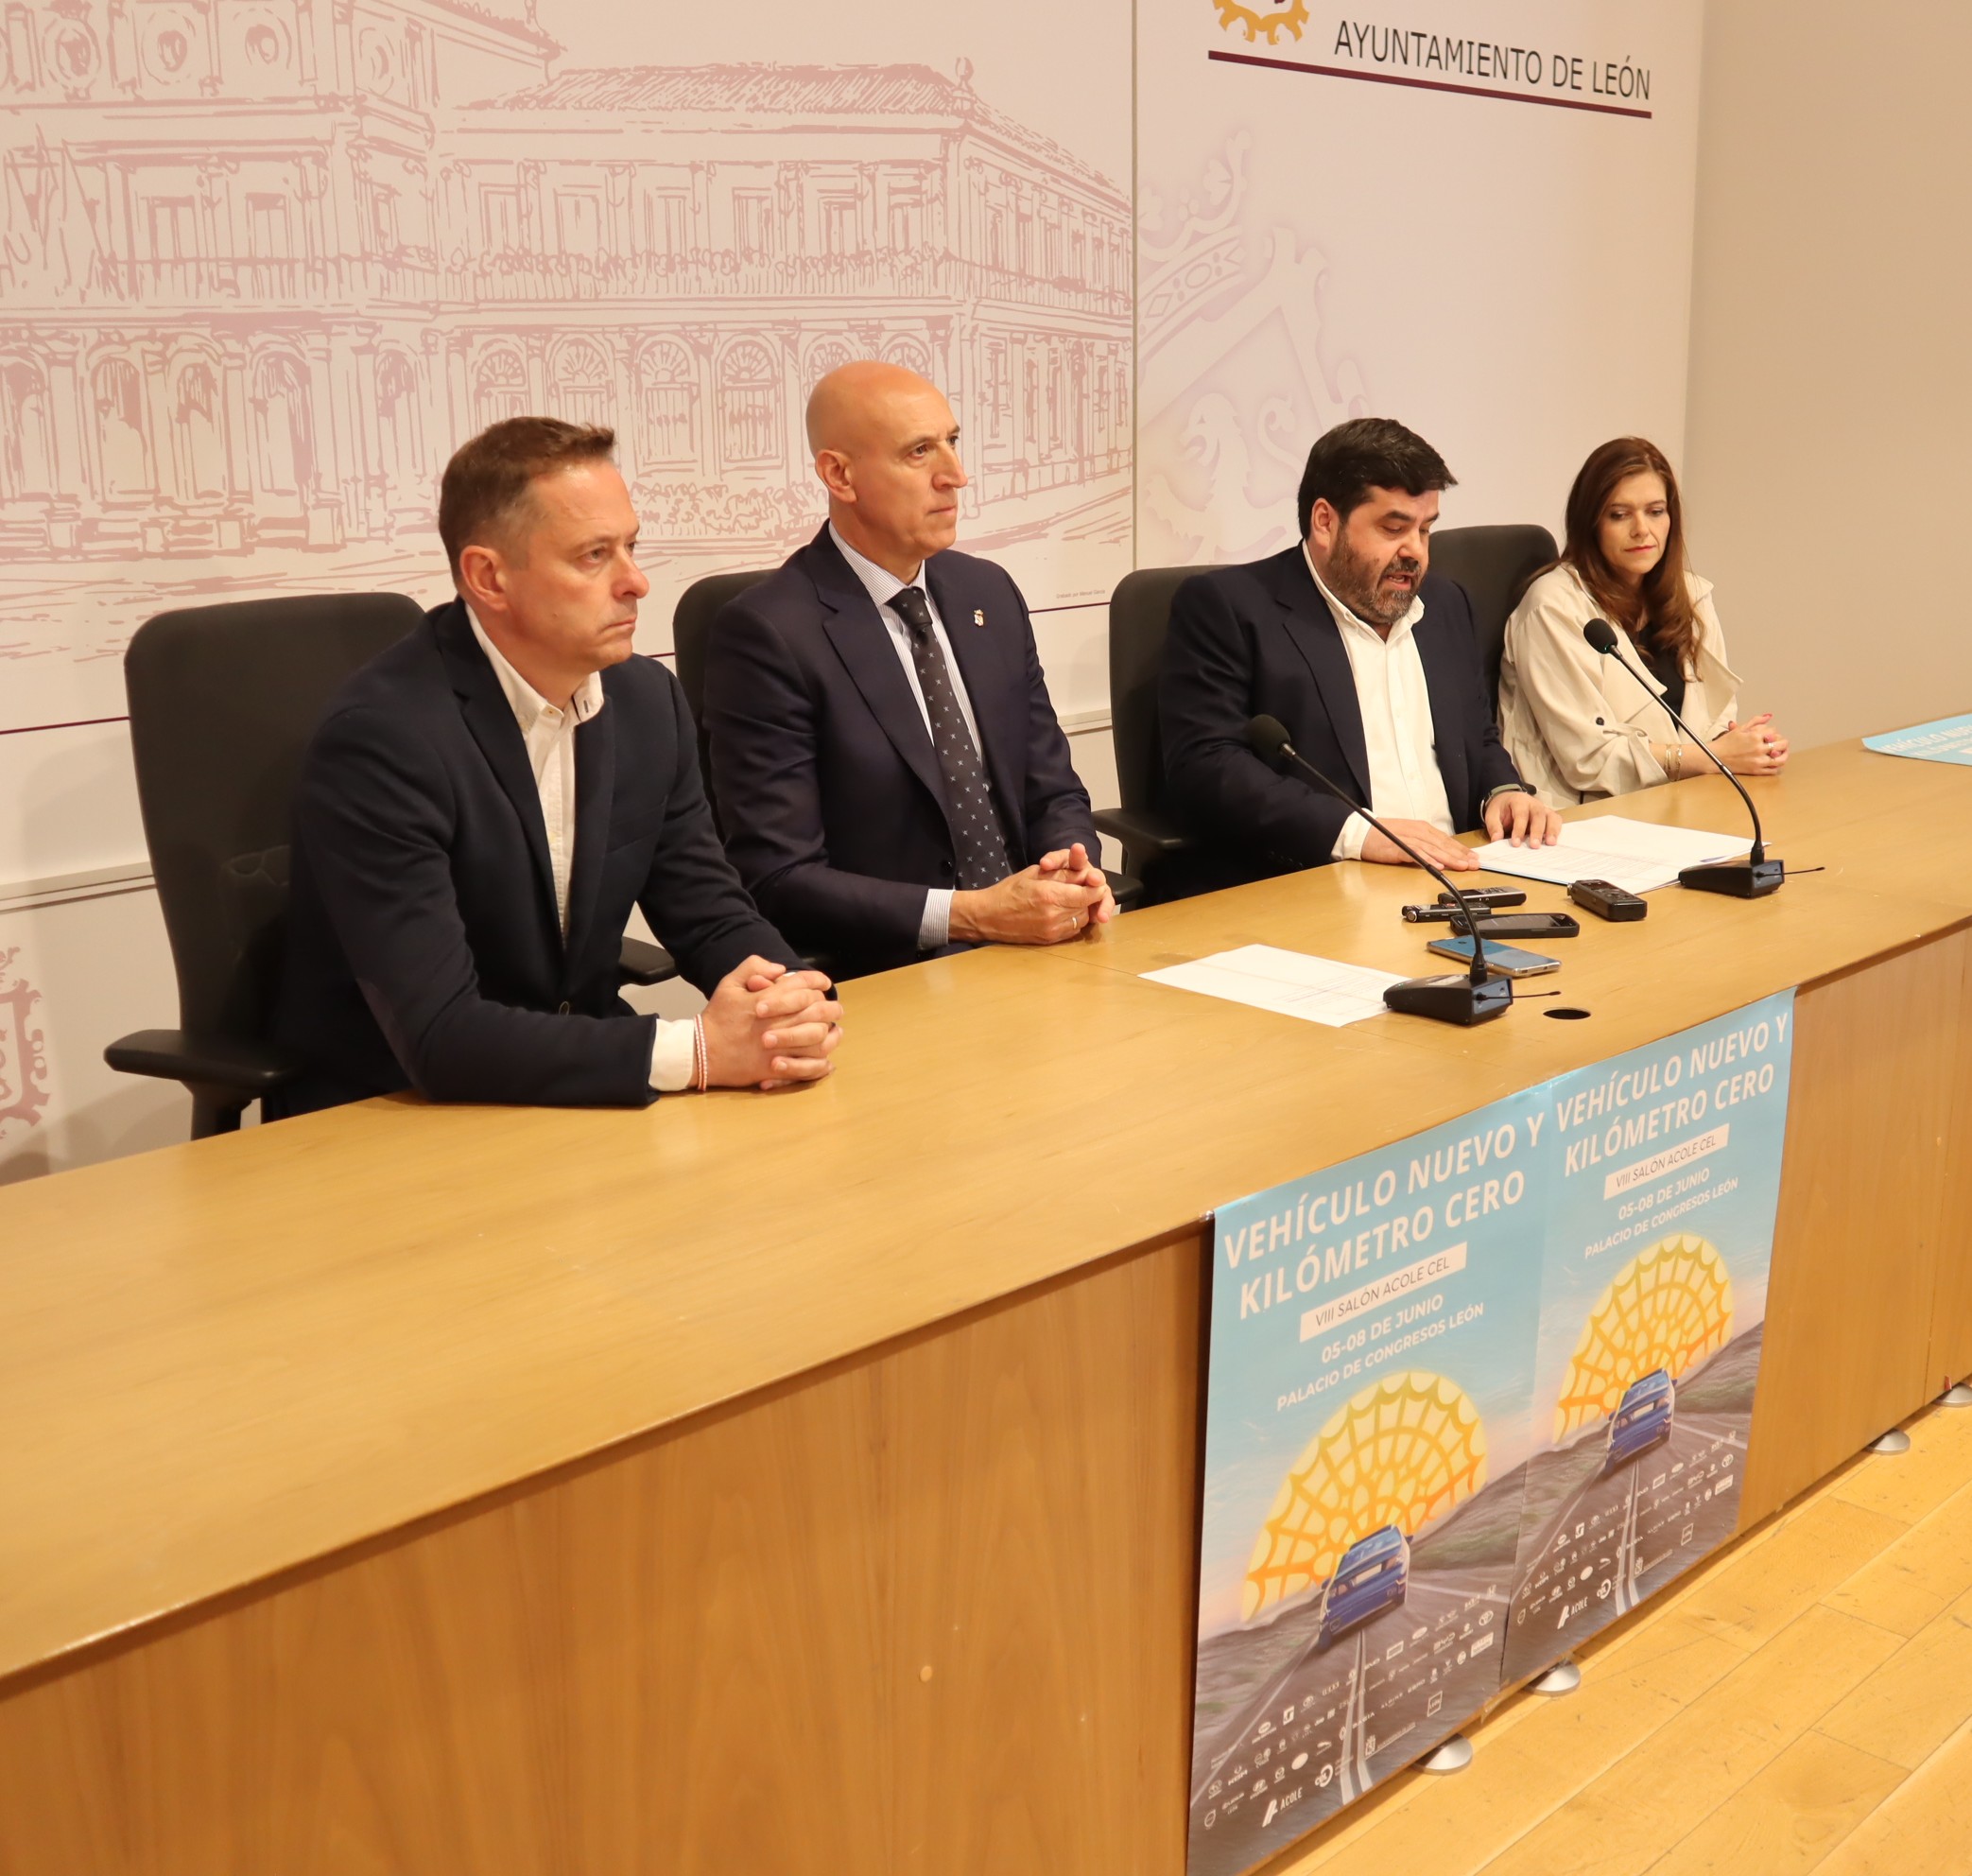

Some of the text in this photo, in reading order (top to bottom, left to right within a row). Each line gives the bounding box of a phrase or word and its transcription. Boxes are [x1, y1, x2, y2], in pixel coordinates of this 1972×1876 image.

[1334, 20, 1651, 100] AYUNTAMIENTO DE LEÓN
[1556, 1013, 1788, 1133] VEHÍCULO NUEVO Y
[1565, 1063, 1774, 1178] KILÓMETRO CERO
[1224, 1112, 1545, 1270] VEHÍCULO NUEVO Y
[1616, 1135, 1717, 1189] VIII SALÓN ACOLE CEL
[1618, 1167, 1710, 1221] 05-08 DE JUNIO
[1240, 1171, 1525, 1320] KILÓMETRO CERO
[1584, 1176, 1738, 1259] PALACIO DE CONGRESOS LEÓN
[1315, 1257, 1450, 1327] VIII SALÓN ACOLE CEL
[1322, 1294, 1444, 1364] 05-08 DE JUNIO
[1277, 1302, 1484, 1412] PALACIO DE CONGRESOS LEÓN
[1571, 1595, 1588, 1617] ACOLE
[1280, 1786, 1303, 1811] ACOLE
